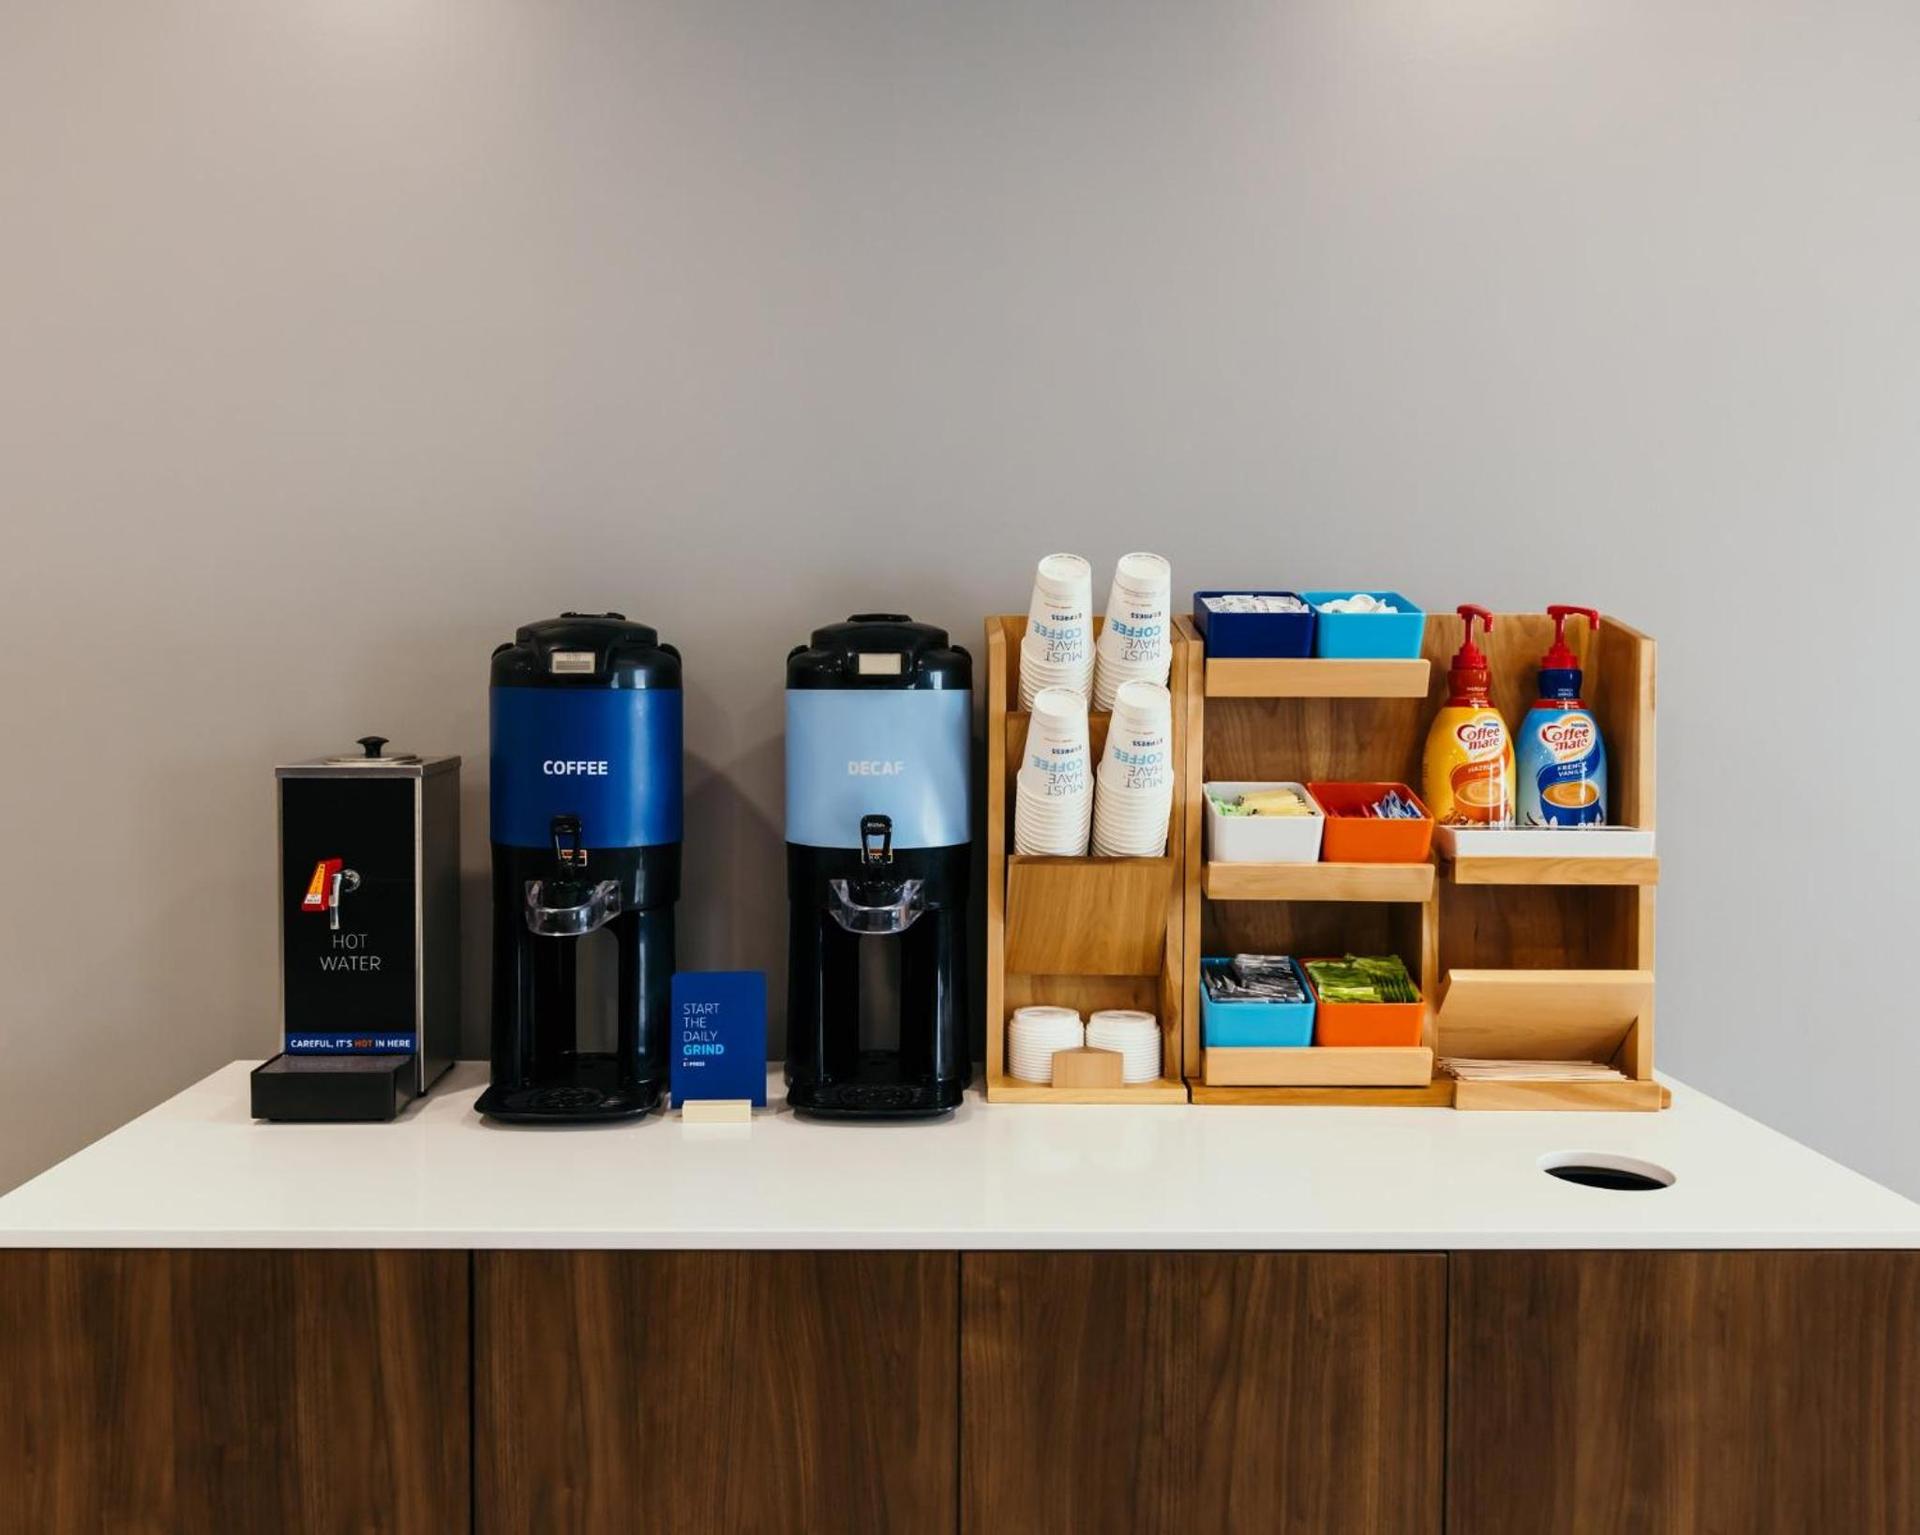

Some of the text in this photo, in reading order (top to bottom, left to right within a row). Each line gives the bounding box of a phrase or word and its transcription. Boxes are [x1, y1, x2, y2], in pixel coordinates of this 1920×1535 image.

[1032, 620, 1082, 640] COFFEE
[1111, 618, 1161, 638] COFFEE
[1046, 639, 1083, 651] HAVE
[1125, 637, 1161, 650] HAVE
[1043, 650, 1083, 663] MUST
[1121, 648, 1161, 662] MUST
[1457, 724, 1500, 742] Coffee
[1542, 725, 1589, 743] Coffee
[1468, 737, 1500, 750] mate
[1554, 737, 1588, 751] mate
[1112, 745, 1164, 766] COFFEE
[543, 760, 608, 776] COFFEE
[848, 760, 904, 776] DECAF
[1031, 754, 1083, 773] COFFEE
[1127, 764, 1163, 777] HAVE
[1048, 770, 1083, 784] HAVE
[1124, 776, 1163, 789] MUST
[1044, 781, 1083, 796] MUST
[332, 933, 368, 949] HOT
[319, 955, 381, 971] WATER
[683, 1003, 721, 1015] START
[683, 1016, 707, 1028] THE
[683, 1030, 718, 1042] DAILY
[291, 1039, 411, 1050] CAREFUL, IT'S HOT IN HERE
[683, 1044, 725, 1056] GRIND
